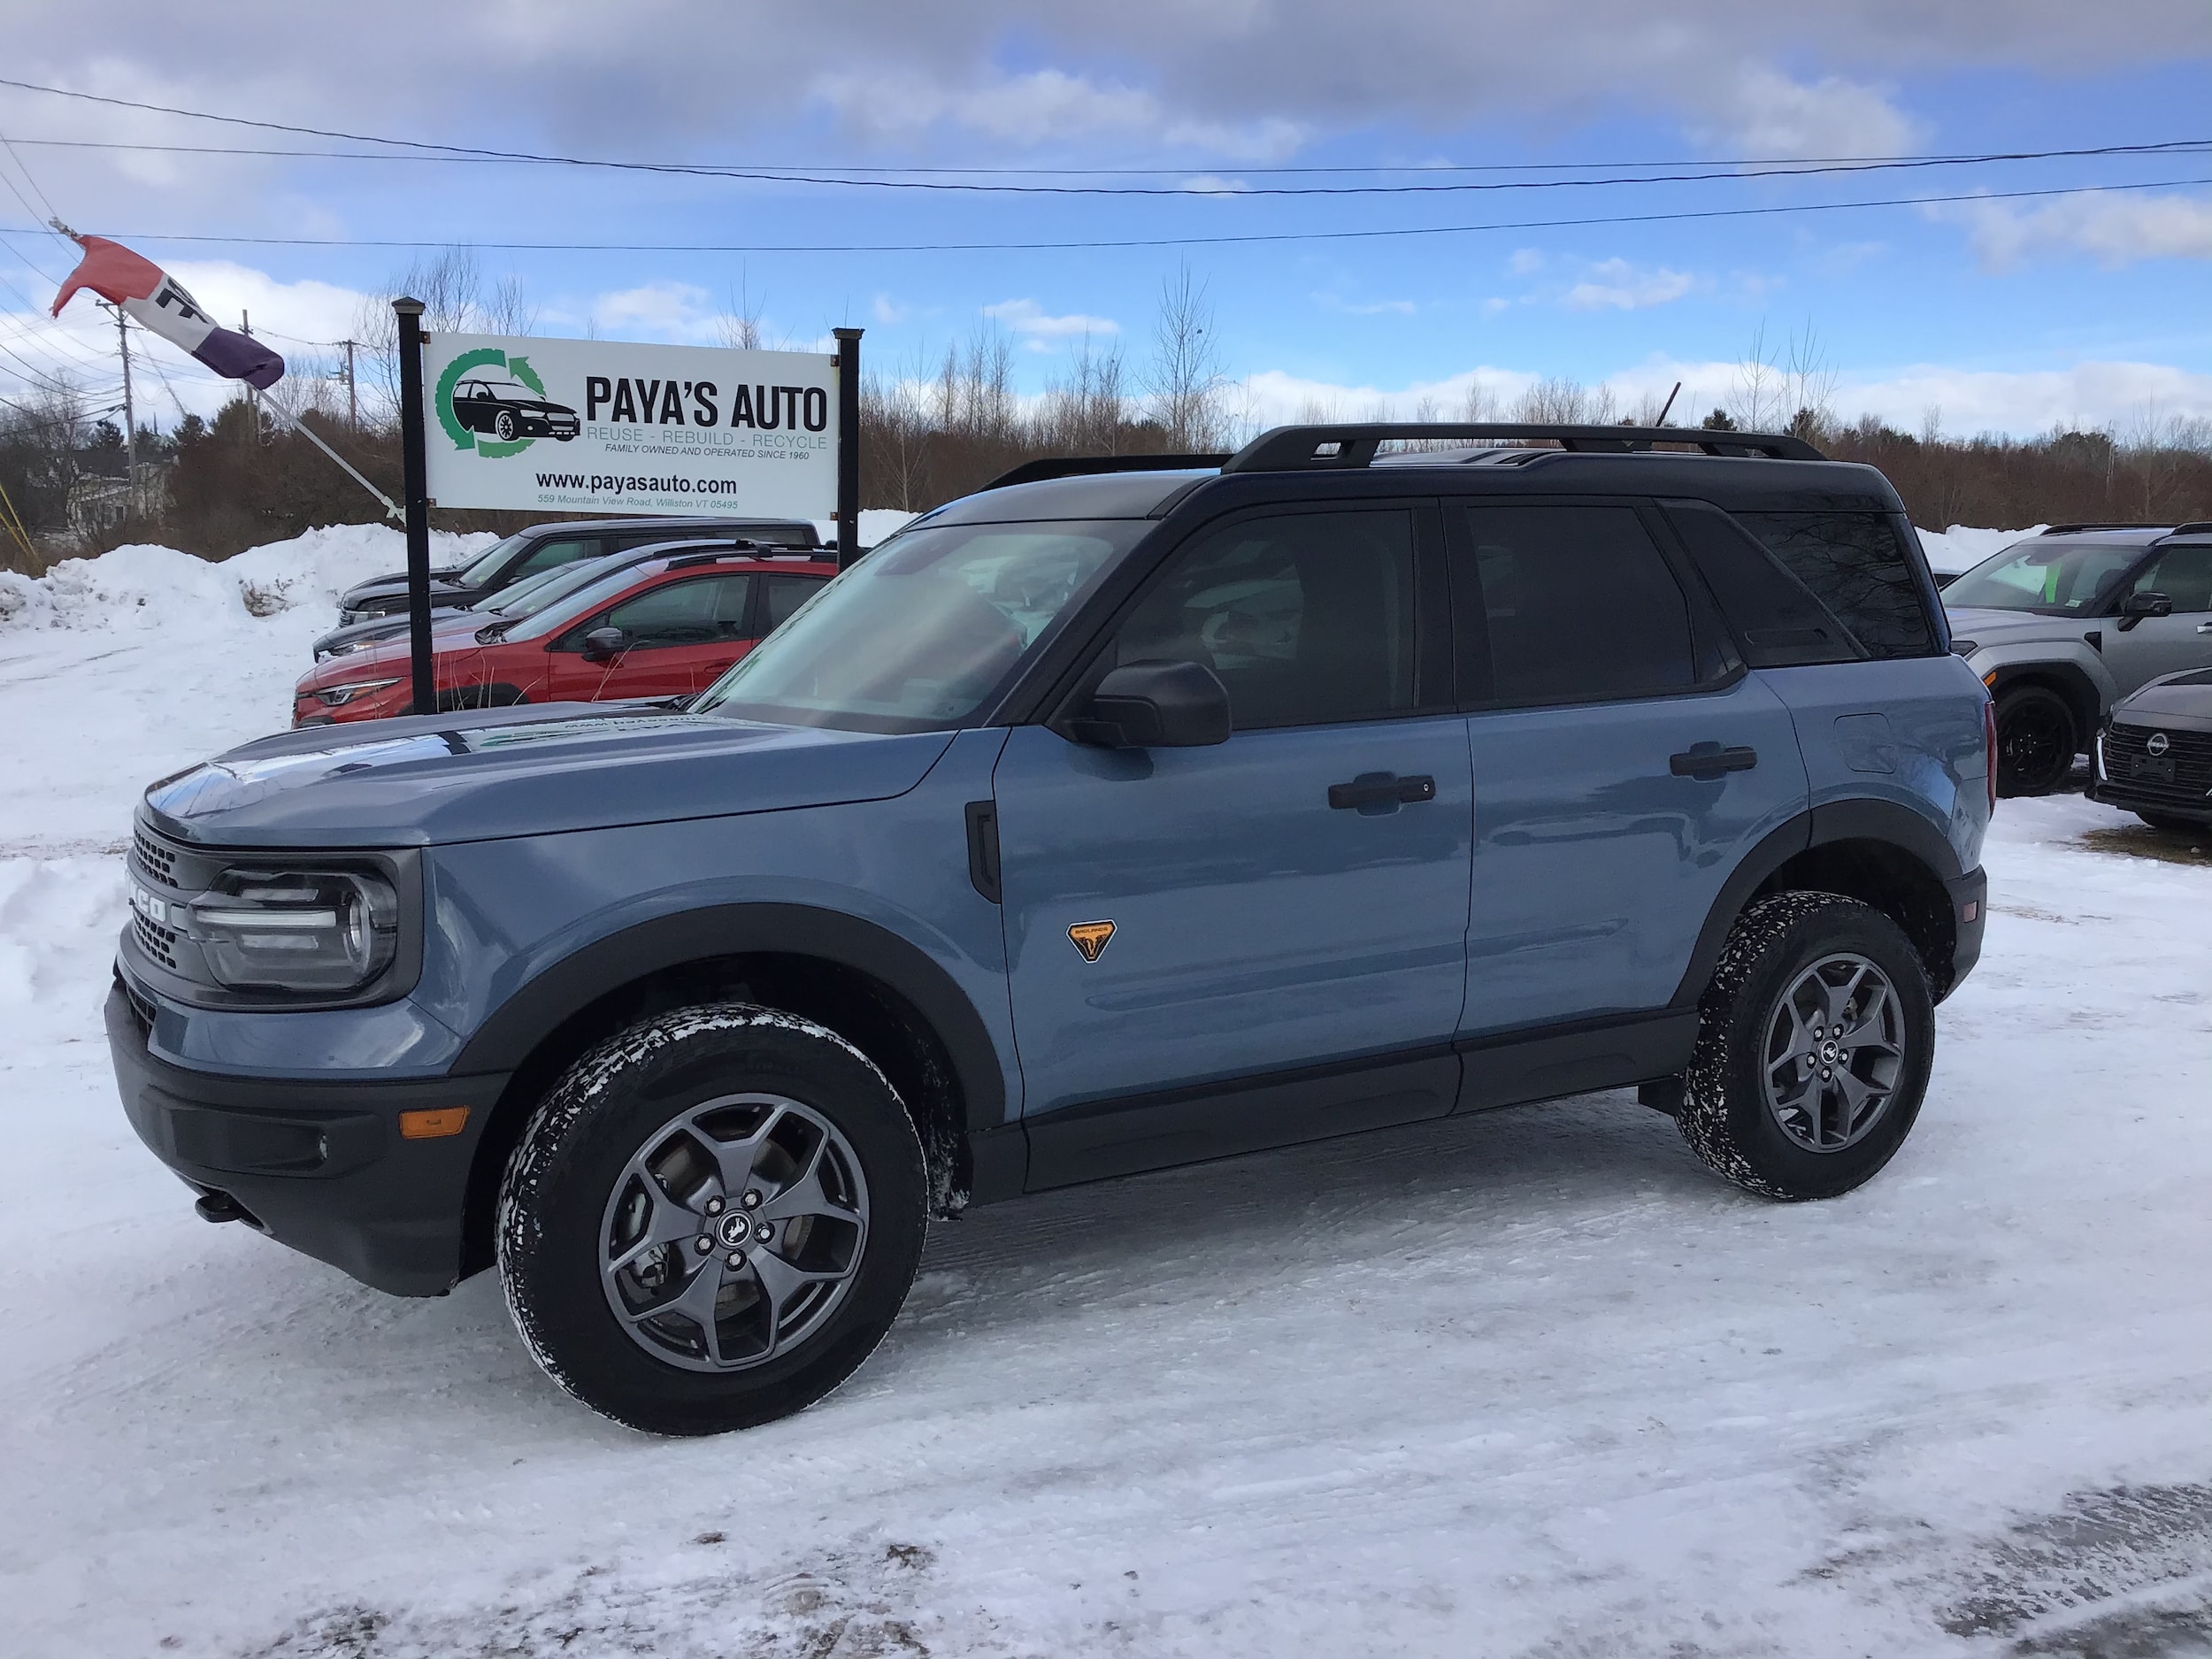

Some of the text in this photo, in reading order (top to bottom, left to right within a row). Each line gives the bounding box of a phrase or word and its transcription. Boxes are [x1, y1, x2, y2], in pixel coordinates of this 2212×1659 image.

[587, 376, 827, 432] PAYA'S AUTO
[587, 426, 644, 442] REUSE
[663, 430, 733, 446] REBUILD
[752, 434, 827, 449] RECYCLE
[604, 443, 810, 460] FAMILY OWNED AND OPERATED SINCE 1960
[535, 472, 737, 495] www.payasauto.com
[537, 495, 739, 510] 559 Mountain View Road, Williston VT 05495
